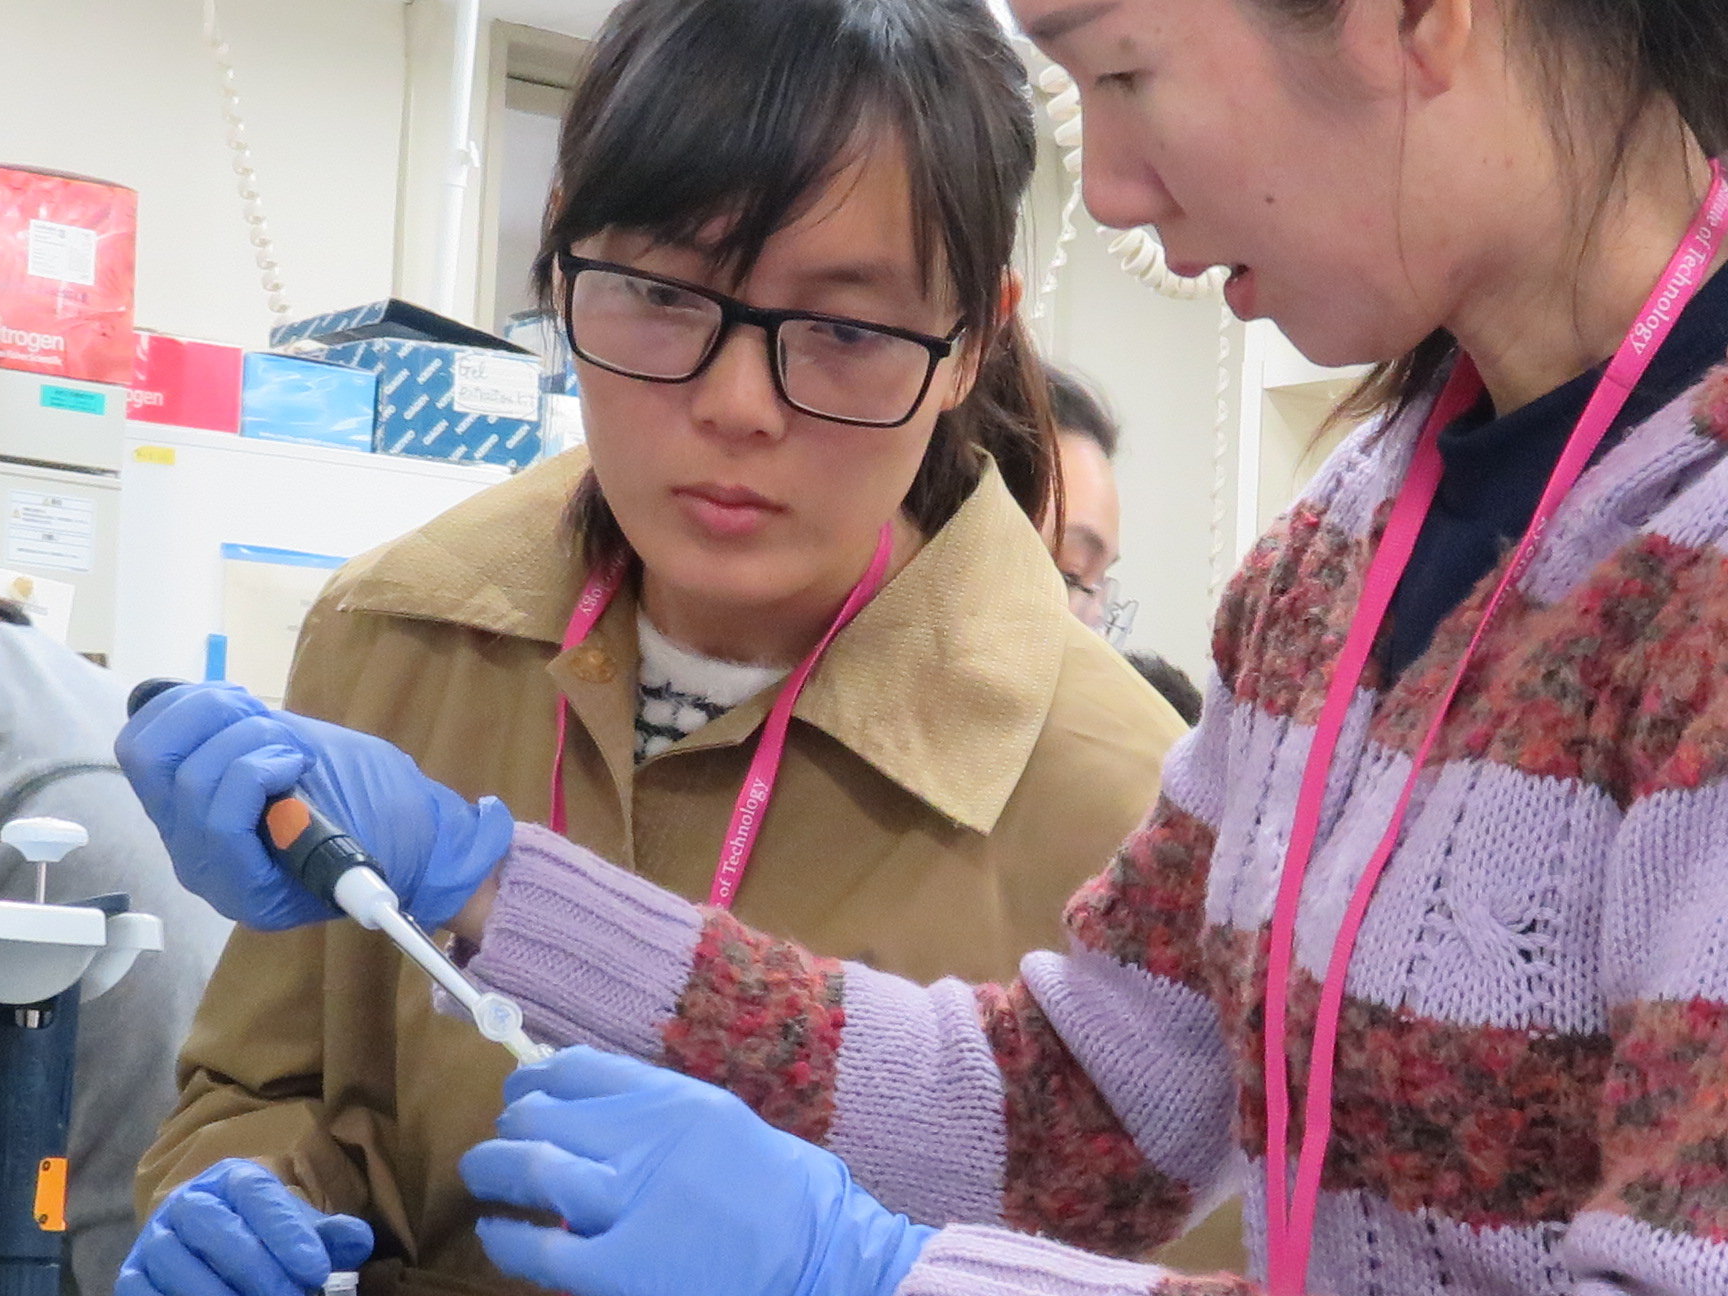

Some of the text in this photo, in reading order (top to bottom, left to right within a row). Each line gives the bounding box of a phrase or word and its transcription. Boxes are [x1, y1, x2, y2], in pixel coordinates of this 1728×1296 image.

[1695, 226, 1713, 250] of
[1629, 247, 1708, 355] Technology
[721, 776, 769, 876] Technology
